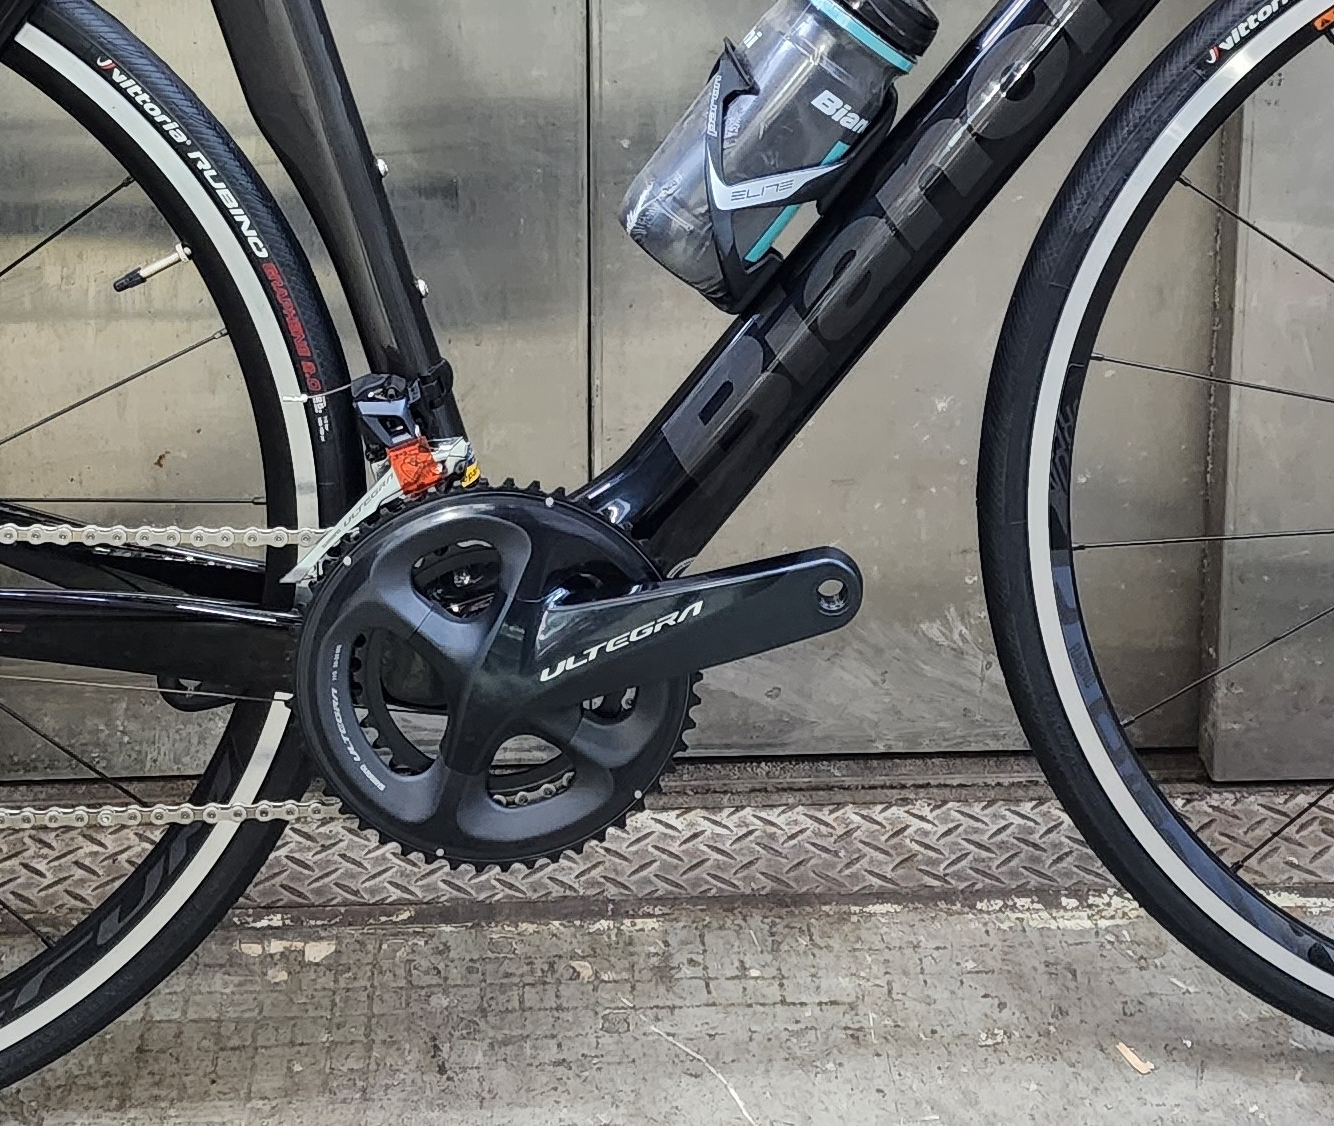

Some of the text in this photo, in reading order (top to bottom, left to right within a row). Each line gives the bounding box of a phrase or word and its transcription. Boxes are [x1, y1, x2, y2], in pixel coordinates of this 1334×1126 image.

[110, 66, 189, 145] vittoria
[186, 150, 270, 260] RUBINO
[730, 178, 795, 202] ELITE
[539, 600, 705, 684] ULTEGRA
[330, 686, 361, 762] ULTEGRA
